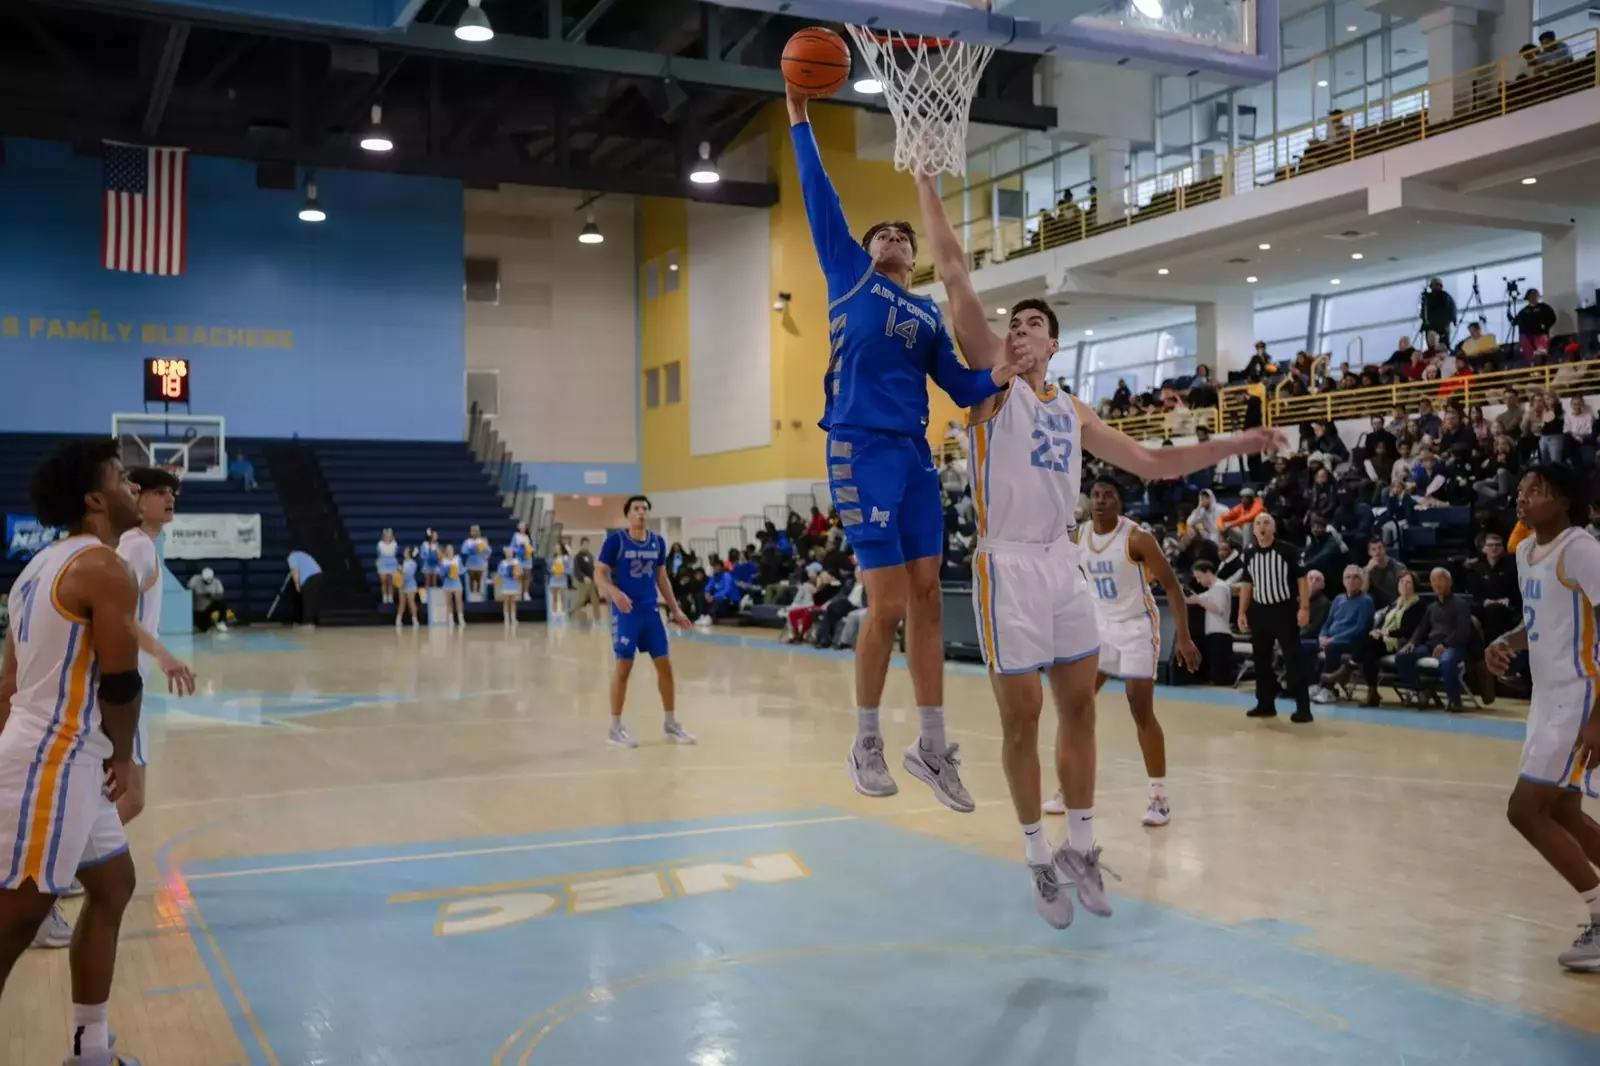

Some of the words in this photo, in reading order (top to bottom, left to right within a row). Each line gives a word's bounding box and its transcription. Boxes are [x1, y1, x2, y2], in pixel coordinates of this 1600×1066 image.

[871, 283, 895, 302] AIR
[29, 308, 133, 343] FAMILY
[142, 323, 293, 349] BLEACHERS
[885, 306, 920, 349] 14
[1031, 429, 1073, 473] 23
[630, 559, 654, 578] 24
[1087, 560, 1114, 574] LIU
[1094, 577, 1117, 599] 10
[1524, 604, 1539, 642] 2
[434, 852, 812, 936] NEC
